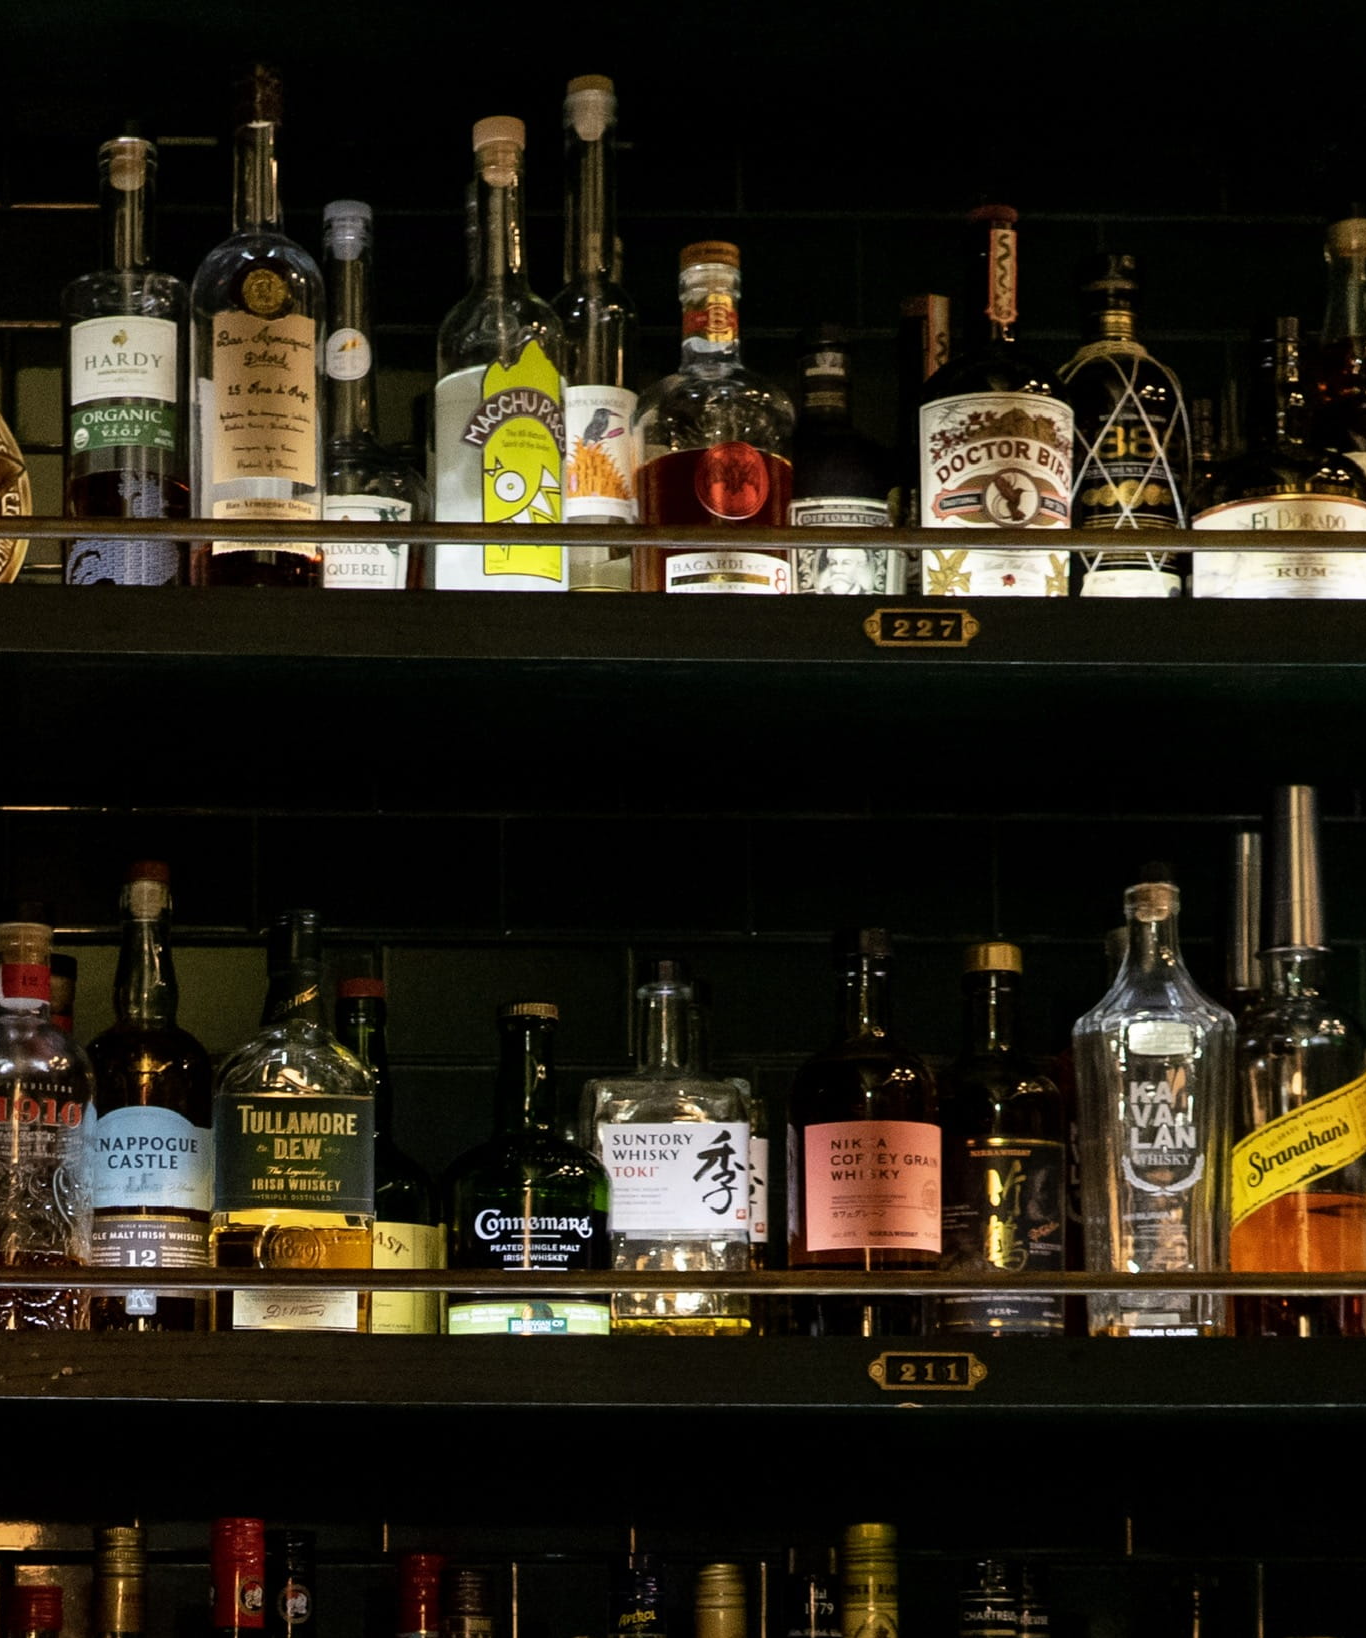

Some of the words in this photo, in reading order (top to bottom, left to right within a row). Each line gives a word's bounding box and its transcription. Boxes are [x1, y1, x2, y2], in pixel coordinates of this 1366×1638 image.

[84, 352, 163, 371] HARDY
[81, 408, 162, 426] ORGANIC
[464, 391, 538, 446] MACCHU
[936, 440, 1031, 484] DOCTOR
[1277, 511, 1347, 530] DORADO
[1277, 567, 1327, 577] RUM
[892, 619, 956, 639] 227
[237, 1104, 358, 1136] TULLAMORE
[612, 1133, 694, 1146] SUNTORY
[1131, 1127, 1196, 1149] LAN
[107, 1154, 179, 1170] CASTLE
[612, 1149, 680, 1161] WHISKY
[1132, 1152, 1191, 1166] WHISKY
[1247, 1120, 1351, 1188] Stranahan's
[612, 1165, 655, 1179] TOKI
[693, 1130, 747, 1215] 季
[251, 1178, 285, 1191] IRISH
[288, 1179, 342, 1192] WHISKEY
[474, 1208, 593, 1241] Connemara
[110, 1231, 135, 1240] MALT
[139, 1231, 166, 1240] IRISH
[169, 1231, 203, 1243] WHISKEY
[490, 1243, 524, 1253] PEATED
[560, 1243, 581, 1253] MALT
[126, 1249, 157, 1268] 12
[503, 1253, 526, 1263] IRISH
[529, 1253, 569, 1263] WHISKEY
[900, 1363, 960, 1382] 211
